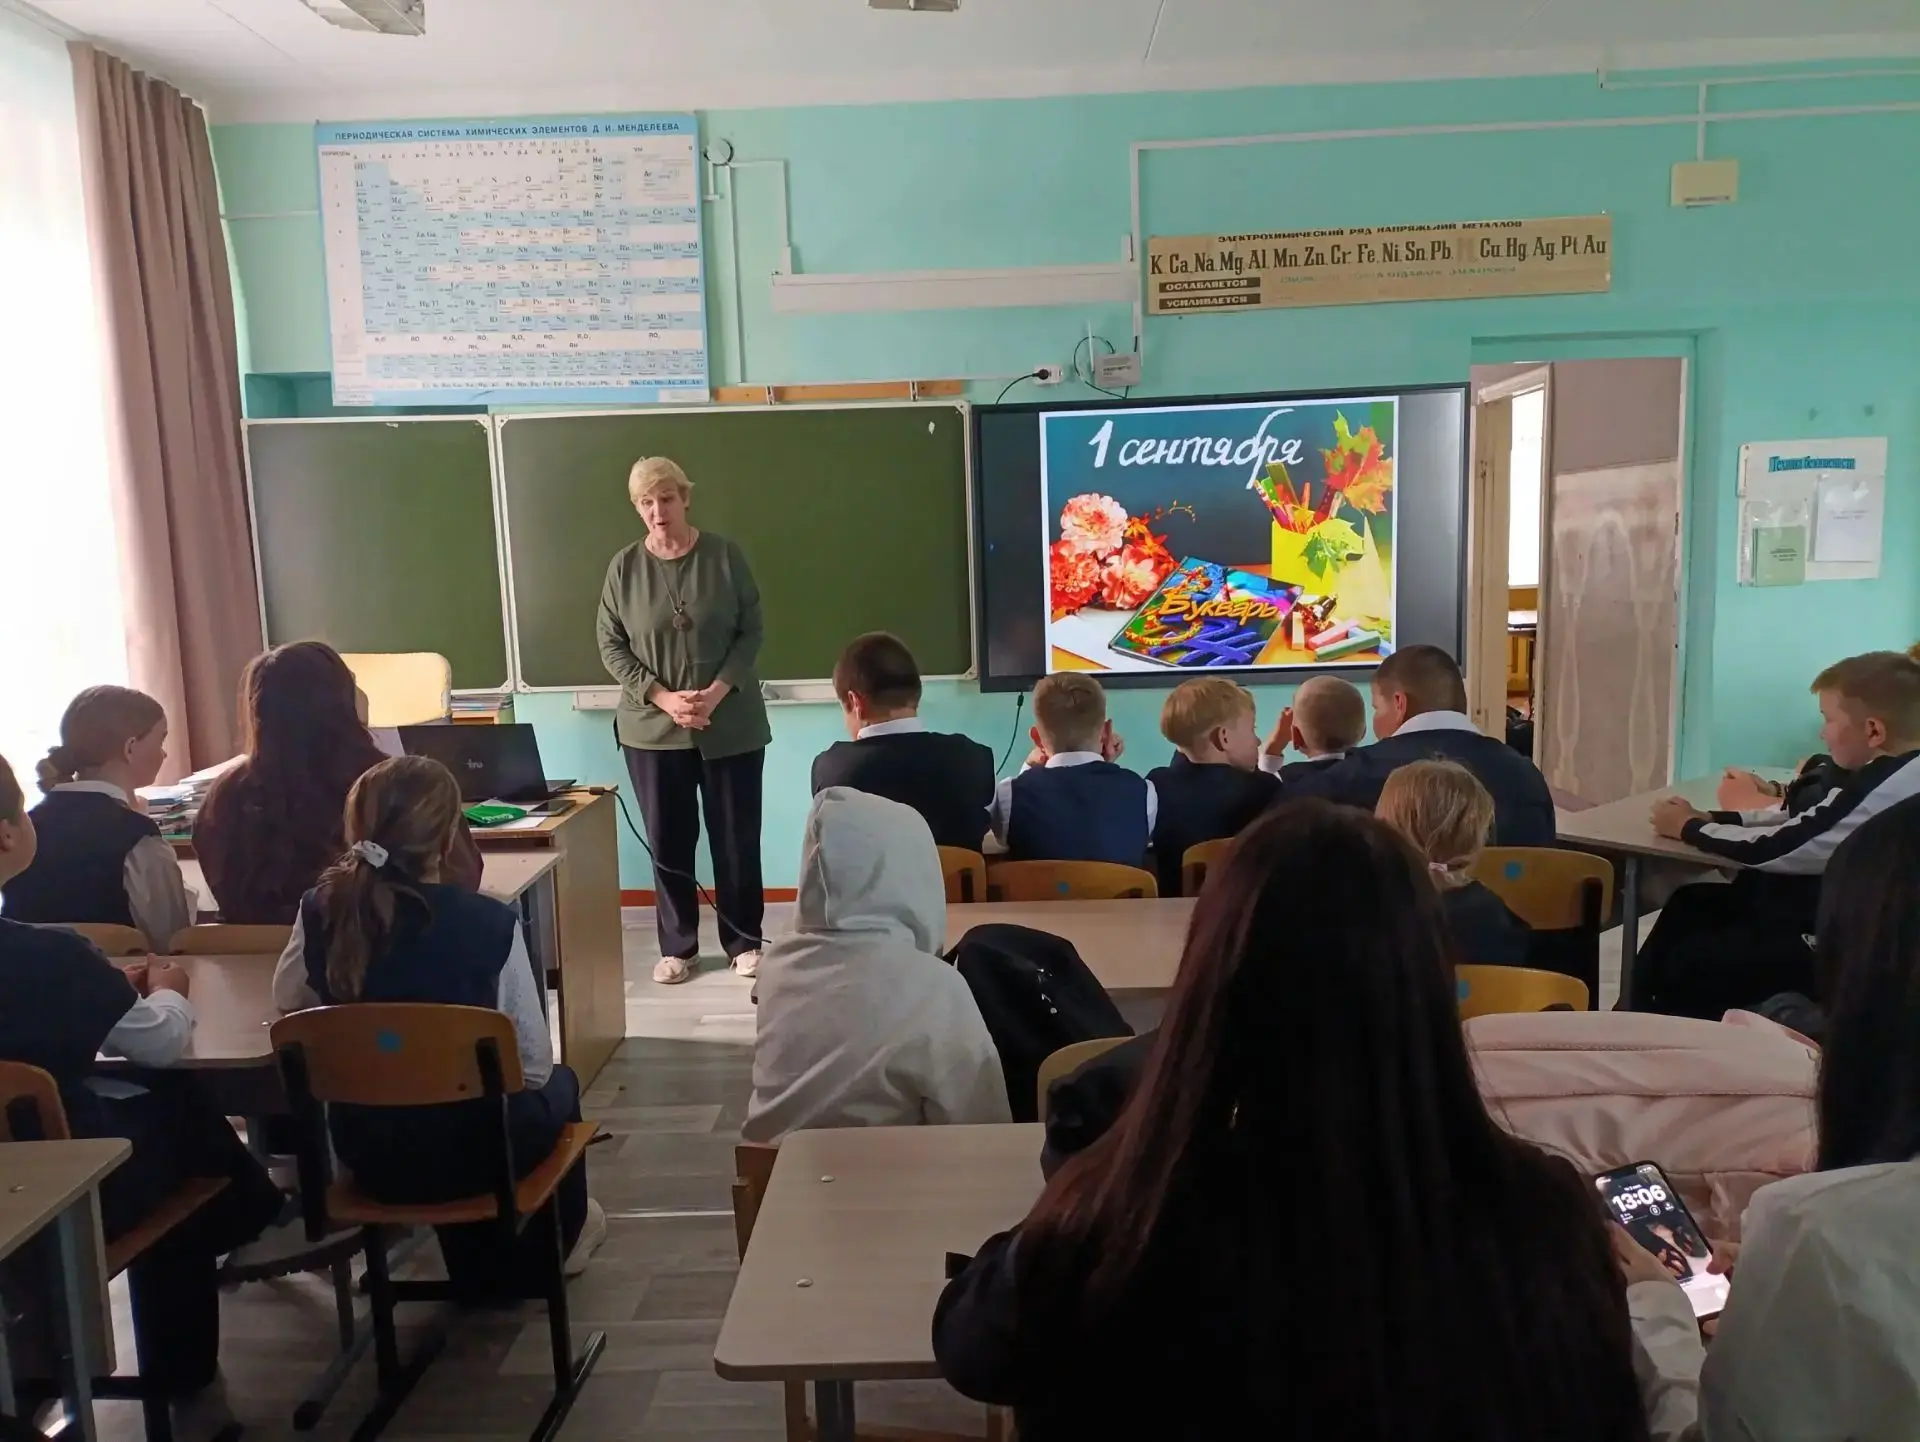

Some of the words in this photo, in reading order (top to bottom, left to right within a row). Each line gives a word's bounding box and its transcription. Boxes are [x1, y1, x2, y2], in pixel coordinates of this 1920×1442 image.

[335, 130, 413, 140] ПЕРИОДИЧЕСКАЯ
[417, 129, 460, 138] СИСТЕМА
[465, 127, 527, 136] ХИМИЧЕСКИХ
[531, 125, 588, 134] ЭЛЕМЕНТОВ
[617, 123, 679, 132] МЕНДЕЛЕЕВА
[1349, 228, 1372, 236] РЯД
[1584, 234, 1607, 254] Au
[1165, 280, 1248, 291] ОСЛАБЛЯЕТСЯ
[1166, 296, 1248, 308] УСИЛИВАЕТСЯ
[1088, 420, 1115, 468] 1
[1118, 408, 1304, 490] сентября
[1158, 591, 1280, 625] Букварь
[1612, 1185, 1667, 1212] 13:06
